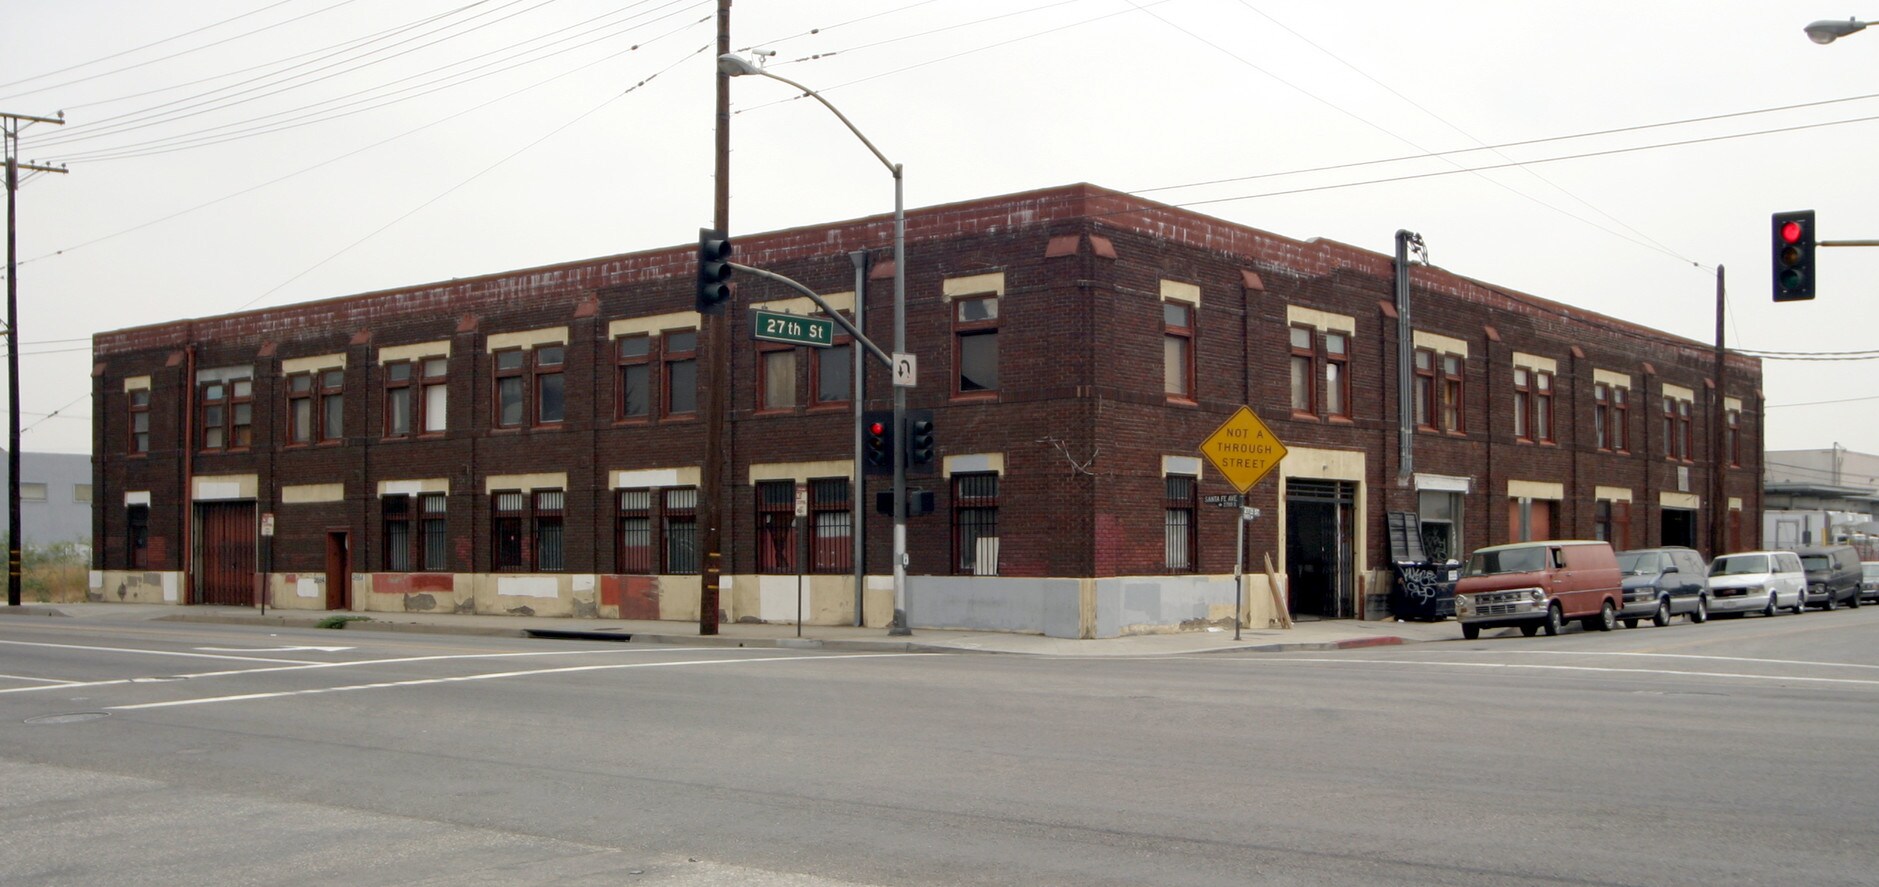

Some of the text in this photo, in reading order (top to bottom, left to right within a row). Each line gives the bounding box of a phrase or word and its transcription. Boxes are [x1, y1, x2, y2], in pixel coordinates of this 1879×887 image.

[767, 319, 823, 338] 27th St
[1226, 428, 1264, 438] NOT A
[1218, 443, 1272, 454] THROUGH
[1222, 458, 1265, 468] STREET
[1228, 494, 1238, 502] AVE
